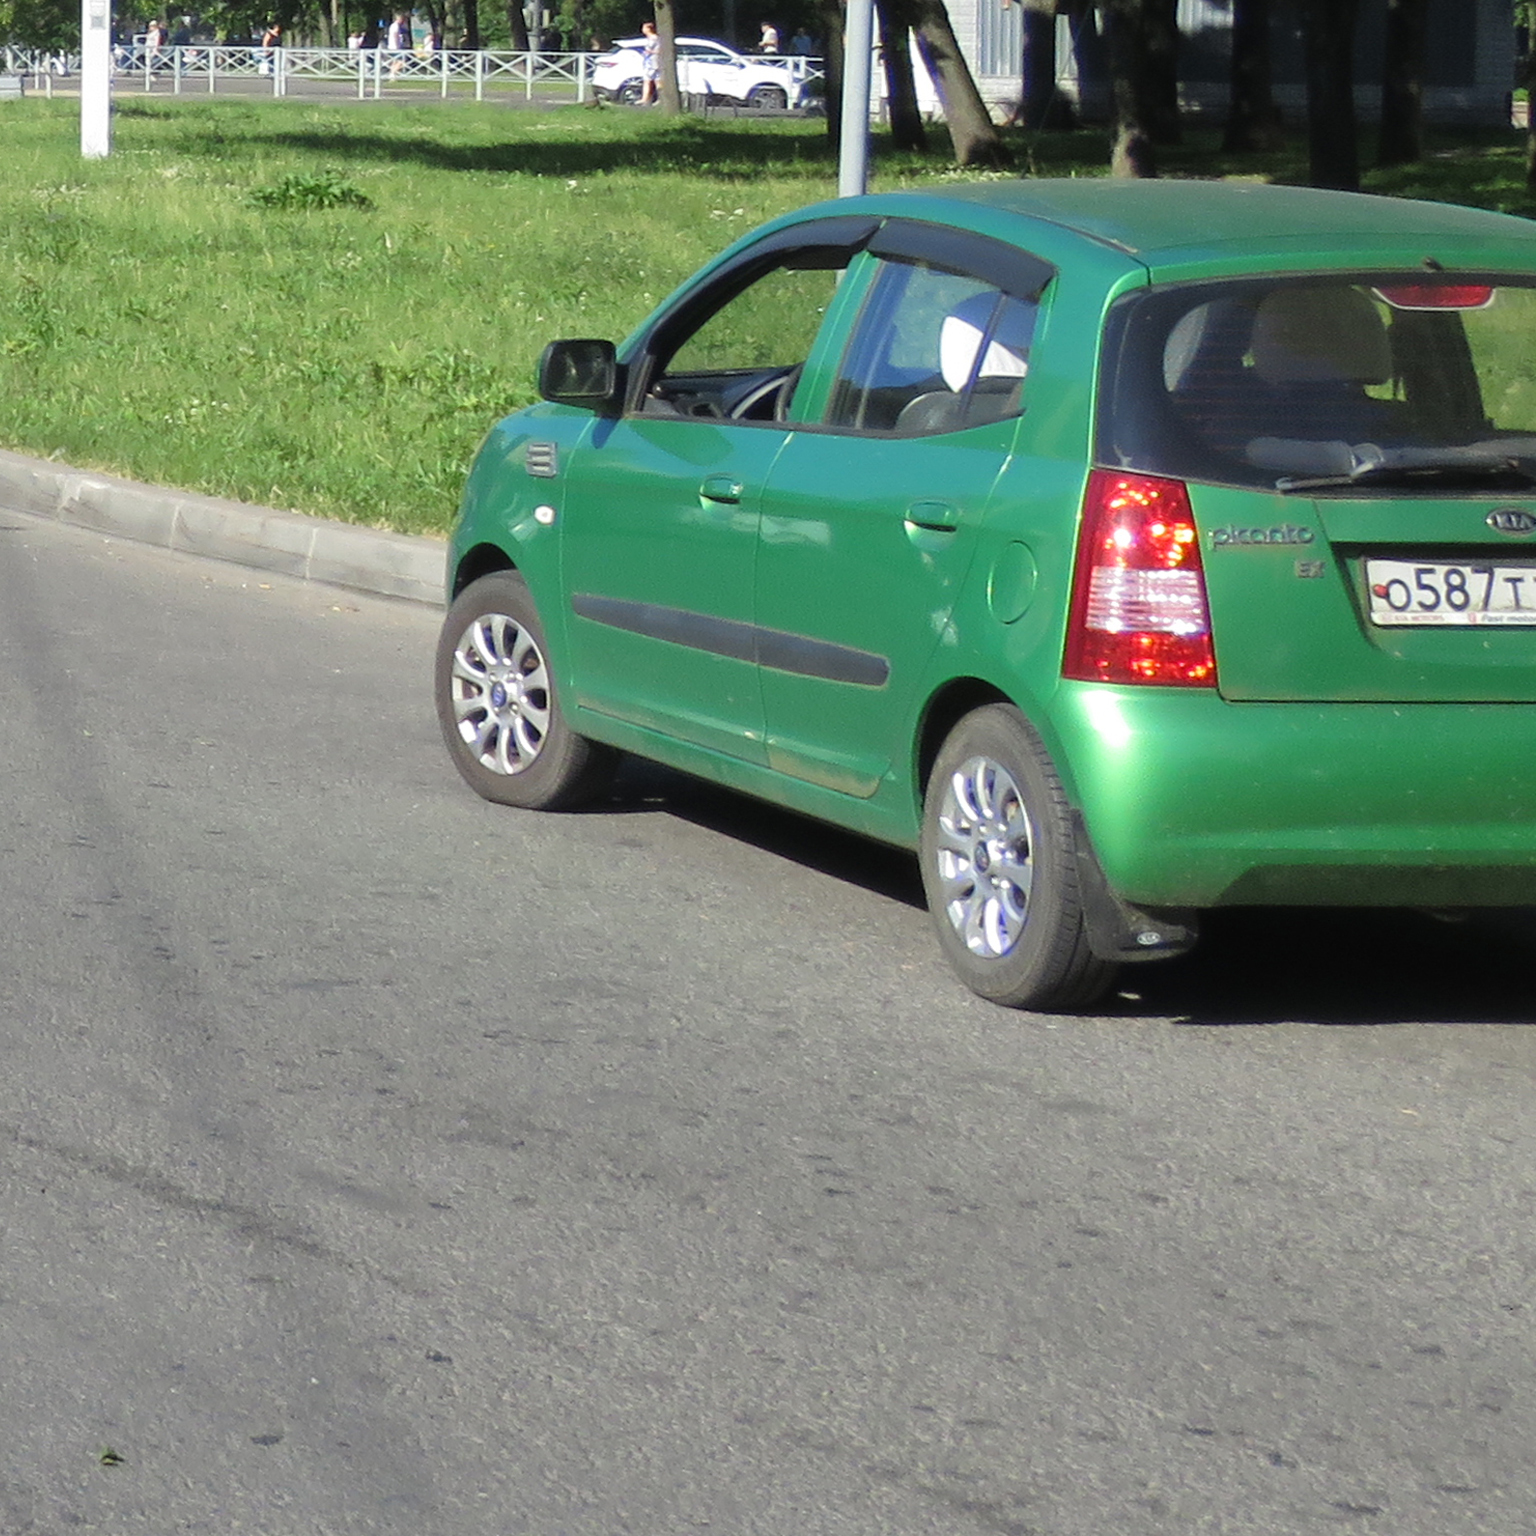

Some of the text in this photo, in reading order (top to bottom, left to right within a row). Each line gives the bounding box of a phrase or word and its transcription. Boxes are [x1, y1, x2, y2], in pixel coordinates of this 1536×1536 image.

[1208, 524, 1314, 551] picanto
[1295, 561, 1326, 578] EX
[1386, 565, 1536, 611] О587Т
